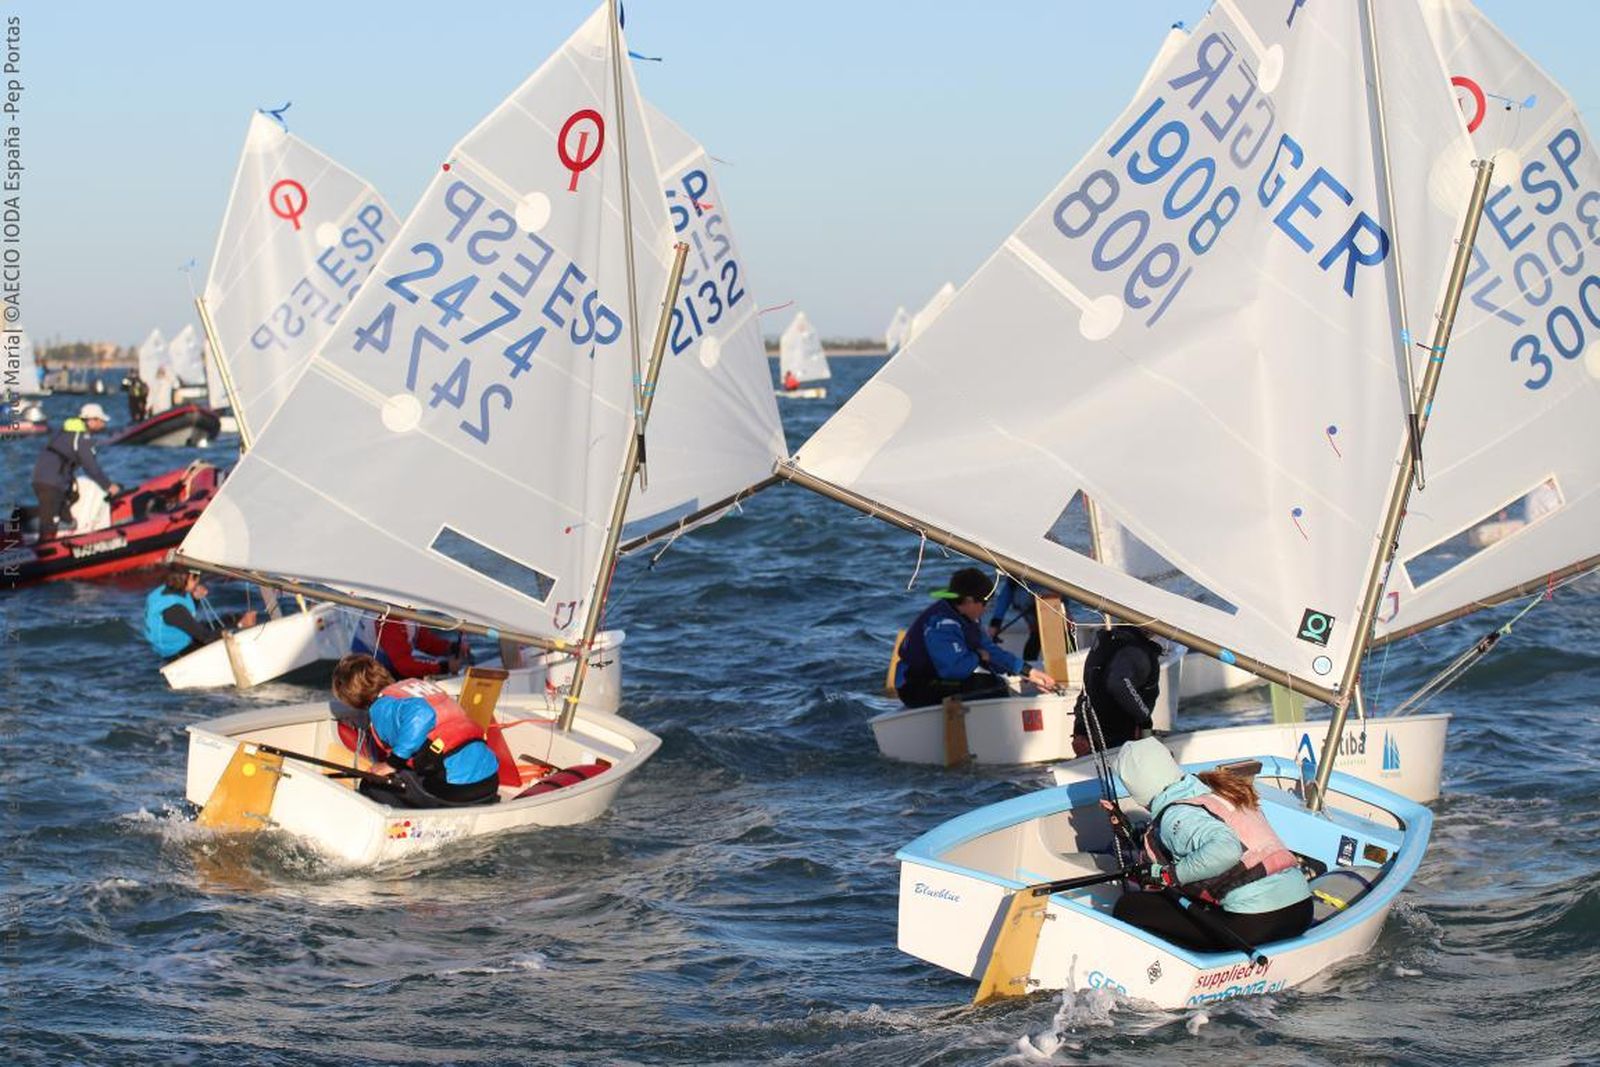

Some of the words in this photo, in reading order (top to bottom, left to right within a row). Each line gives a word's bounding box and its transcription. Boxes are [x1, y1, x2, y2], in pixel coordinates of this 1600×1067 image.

[1108, 96, 1241, 257] 1908
[1257, 132, 1391, 298] GER
[1484, 128, 1582, 251] ESP
[316, 204, 385, 288] ESP
[386, 240, 547, 379] 2474
[541, 261, 622, 358] ESP
[670, 259, 745, 356] 2132
[1195, 963, 1255, 990] supplied
